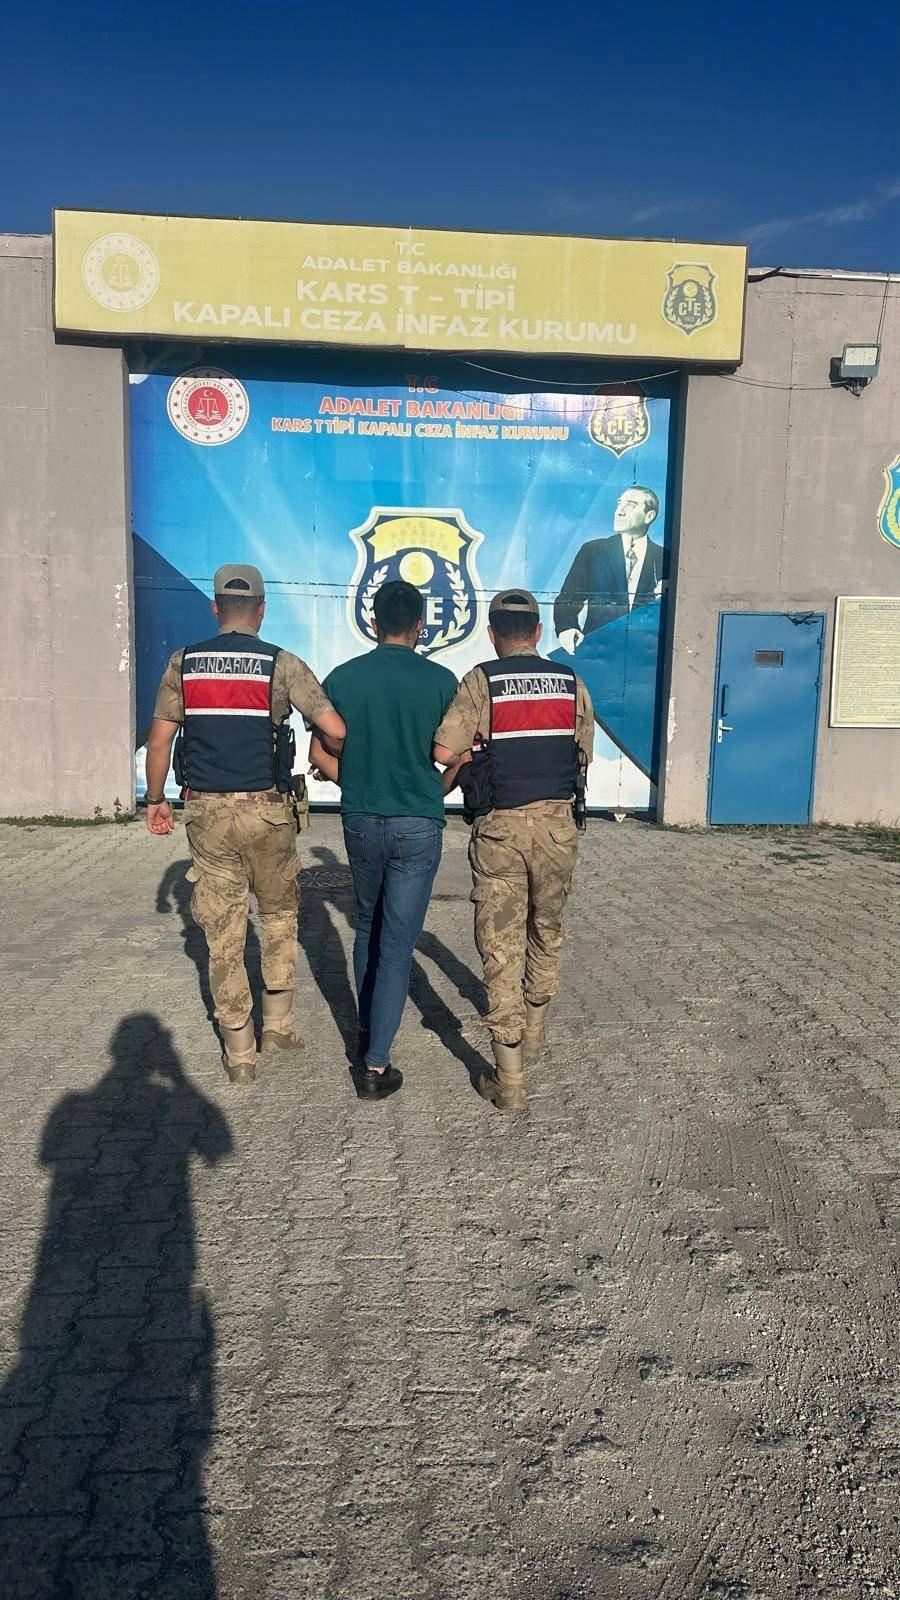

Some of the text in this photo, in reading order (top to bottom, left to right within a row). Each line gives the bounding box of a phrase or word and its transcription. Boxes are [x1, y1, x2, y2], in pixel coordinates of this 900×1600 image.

[301, 255, 517, 279] ADALET BAKANLIĞI
[296, 279, 389, 305] KARS
[397, 284, 420, 306] T
[454, 283, 516, 311] TİPİ
[678, 297, 702, 316] CTE
[173, 301, 637, 345] KAPALI CEZA İNFAZ KURUMU
[318, 397, 525, 421] ADALET BAKANLIĞI
[271, 416, 569, 441] KARS T TİPİ KAPALI CEZA İNFAZ KURUMU
[607, 416, 633, 435] CTE
[190, 657, 263, 674] JANDARMA
[501, 678, 568, 695] JANDARMA
